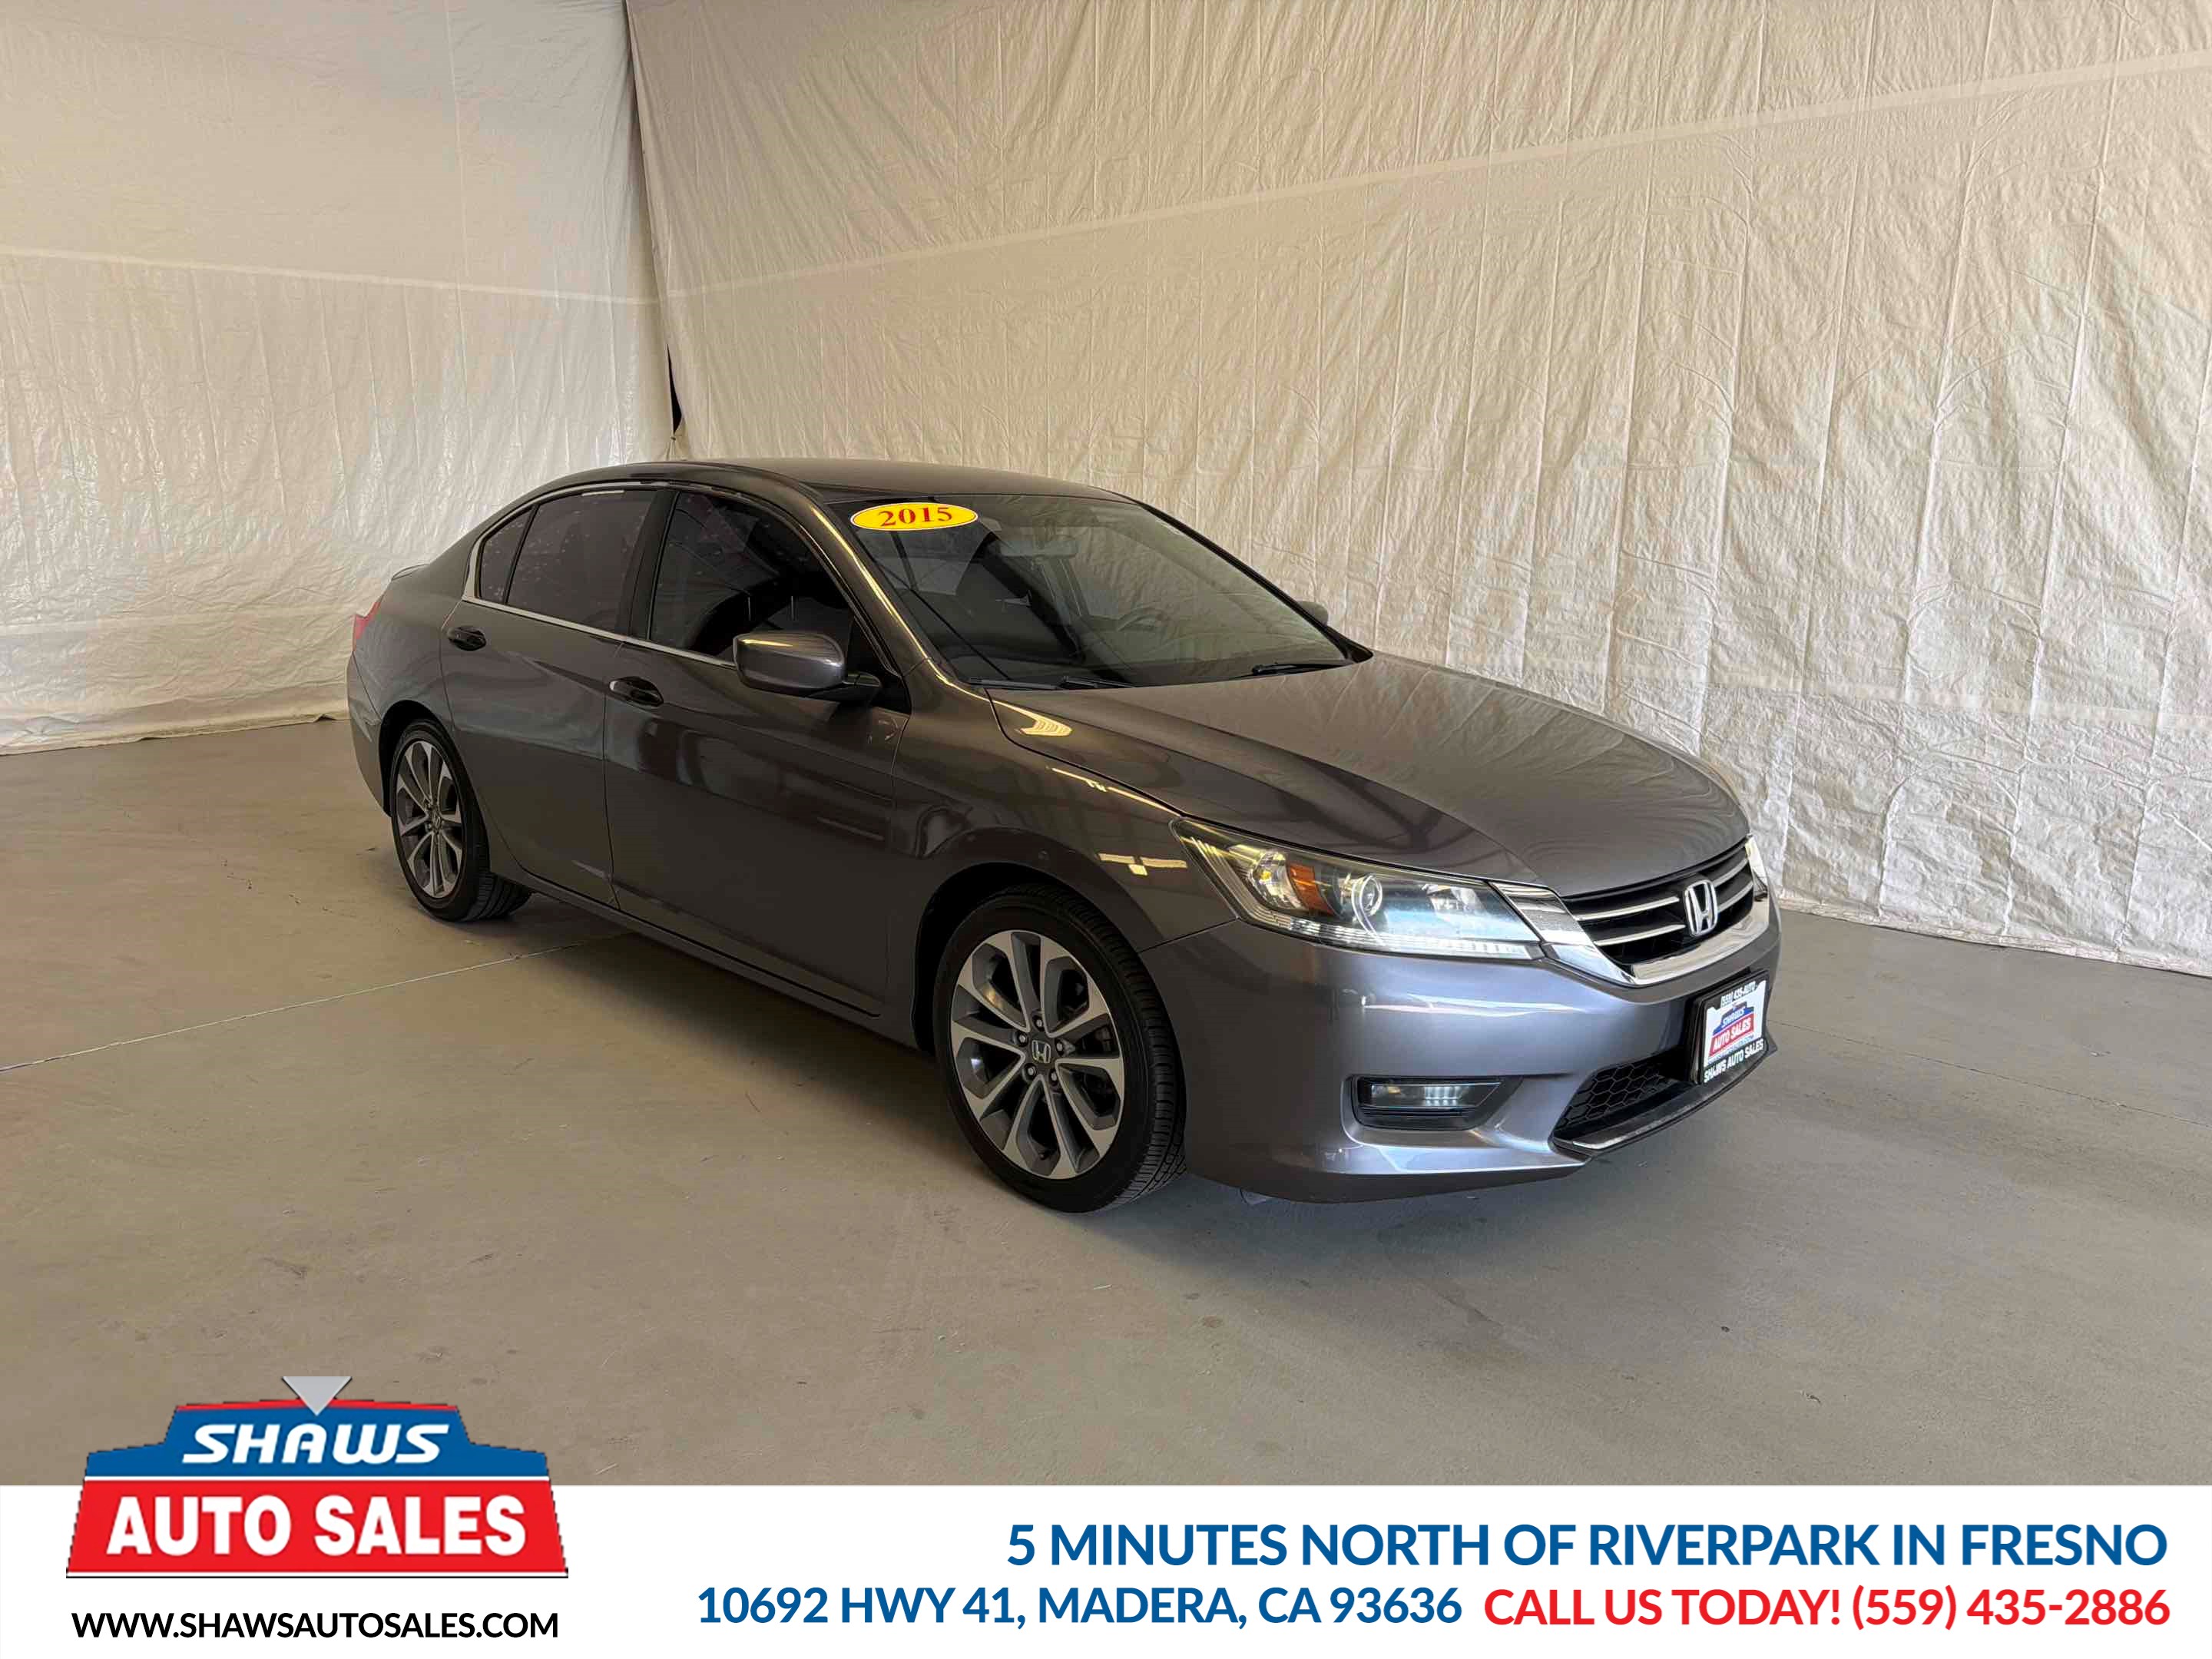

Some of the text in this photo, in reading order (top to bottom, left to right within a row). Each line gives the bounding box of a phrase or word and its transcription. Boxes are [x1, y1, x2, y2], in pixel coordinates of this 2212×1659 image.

[878, 507, 952, 527] 2015
[1714, 1029, 1730, 1051] AUTO
[1731, 1018, 1751, 1039] SALES
[1704, 1059, 1727, 1083] SHAWS
[1727, 1049, 1744, 1068] AUTO
[1745, 1038, 1763, 1058] SALES
